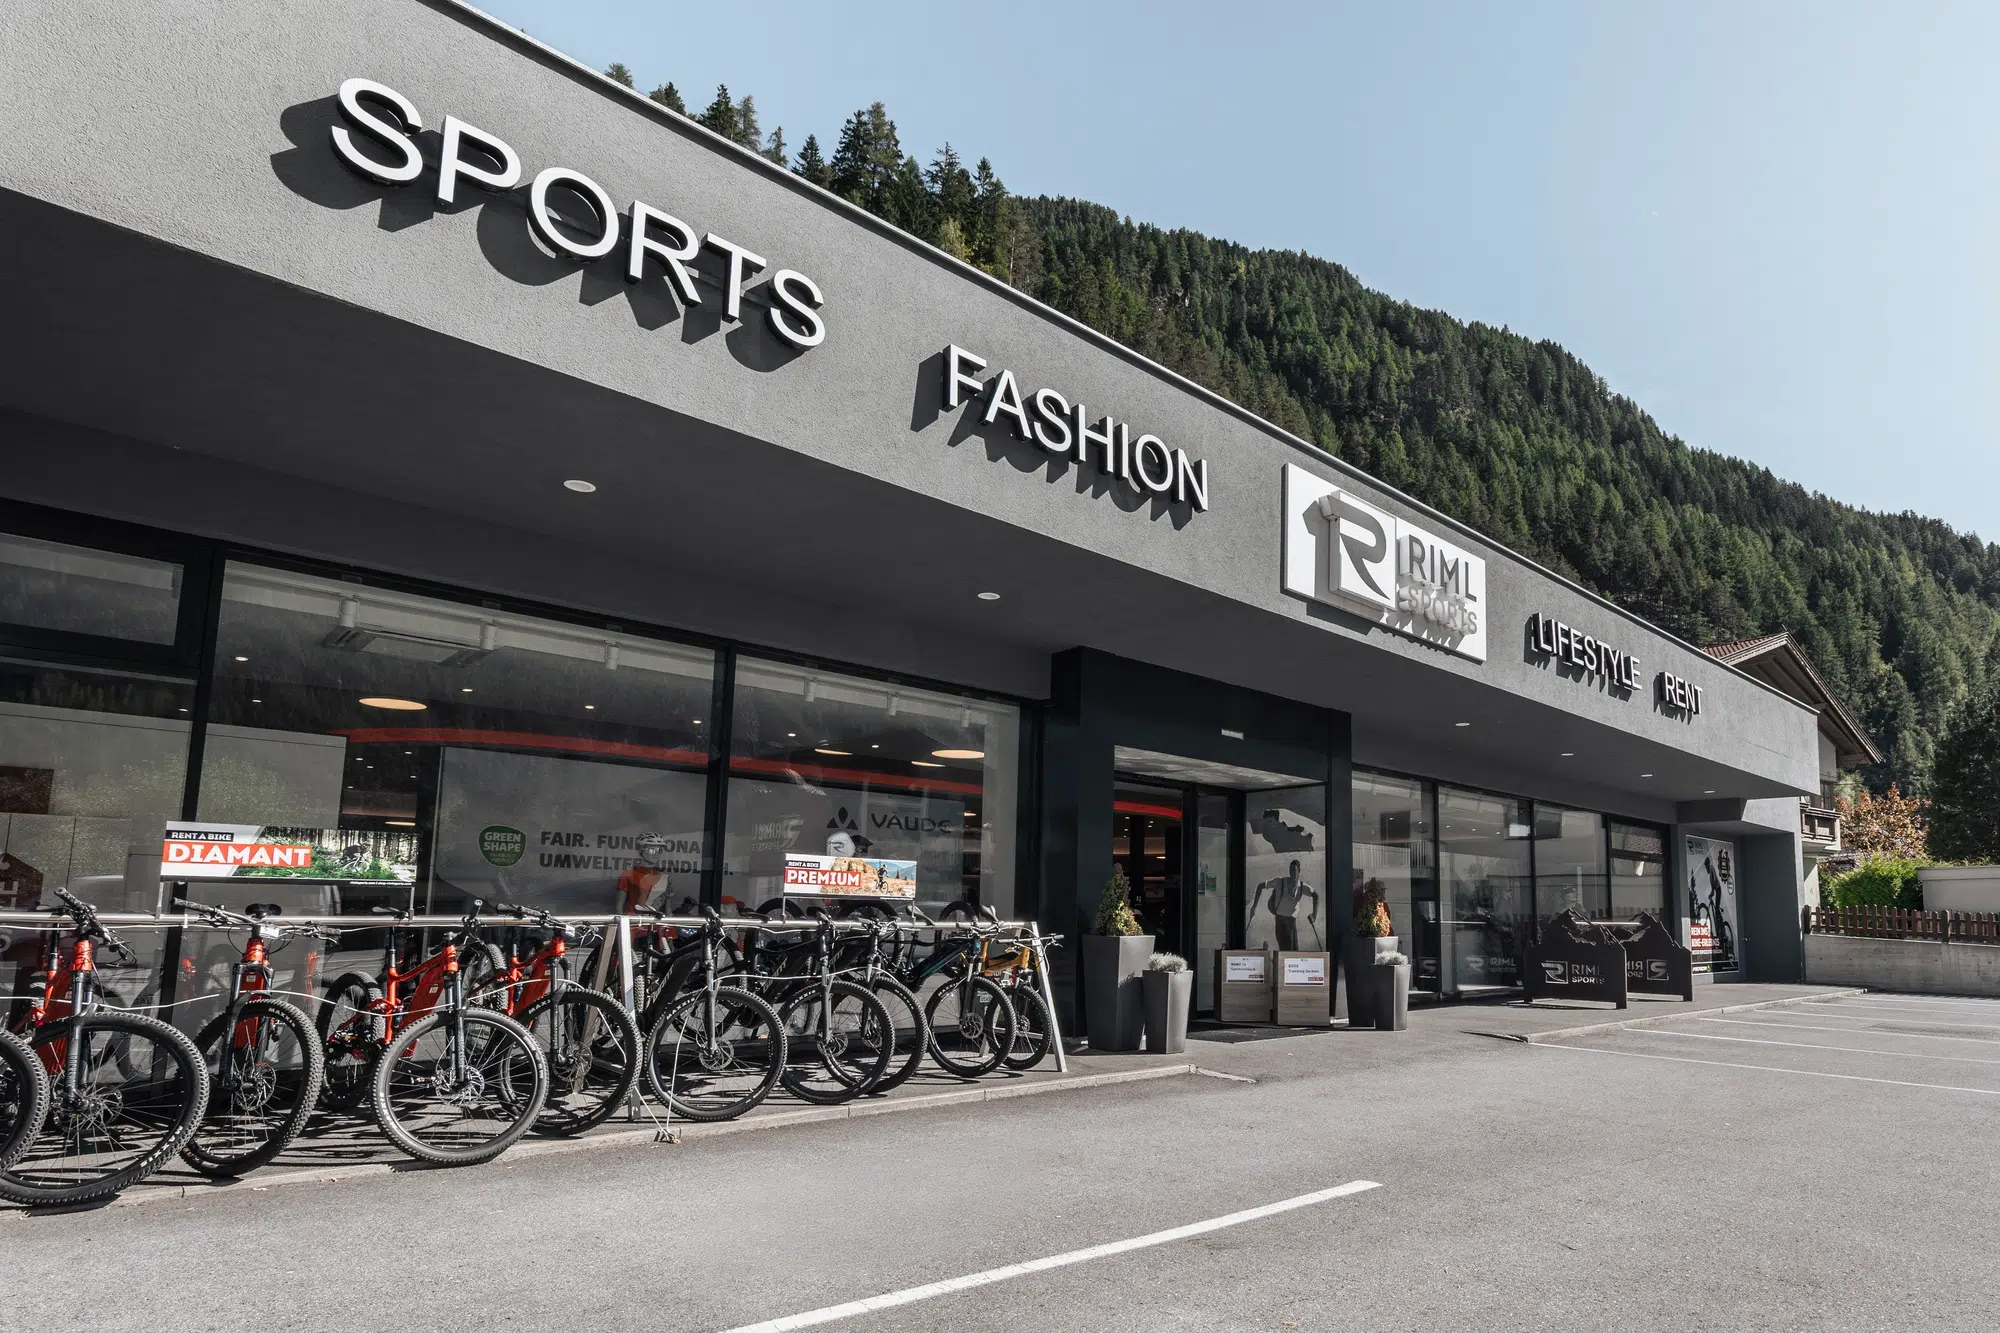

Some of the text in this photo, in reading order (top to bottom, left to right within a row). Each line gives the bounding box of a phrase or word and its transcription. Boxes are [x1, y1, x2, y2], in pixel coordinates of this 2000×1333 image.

[331, 78, 826, 350] SPORTS
[944, 344, 1209, 513] FASHION
[1407, 534, 1477, 602] RIML
[1408, 585, 1478, 635] SPORTS
[1538, 612, 1703, 715] LIFESTYLE RENT
[171, 831, 198, 840] RENT
[207, 833, 232, 841] BIKE
[483, 841, 521, 852] SHAPE
[484, 831, 521, 842] GREEN
[540, 831, 701, 854] FAIR. FUNONA
[168, 843, 312, 866] DIAMANT
[787, 869, 860, 887] PREMIUM
[1571, 976, 1605, 985] SPORTS
[528, 1000, 551, 1015] MAX
[666, 997, 695, 1020] MAXXIS
[789, 989, 816, 1009] MAXXIS
[268, 1006, 296, 1029] MAXXIS
[140, 1125, 184, 1168] MAXXIS
